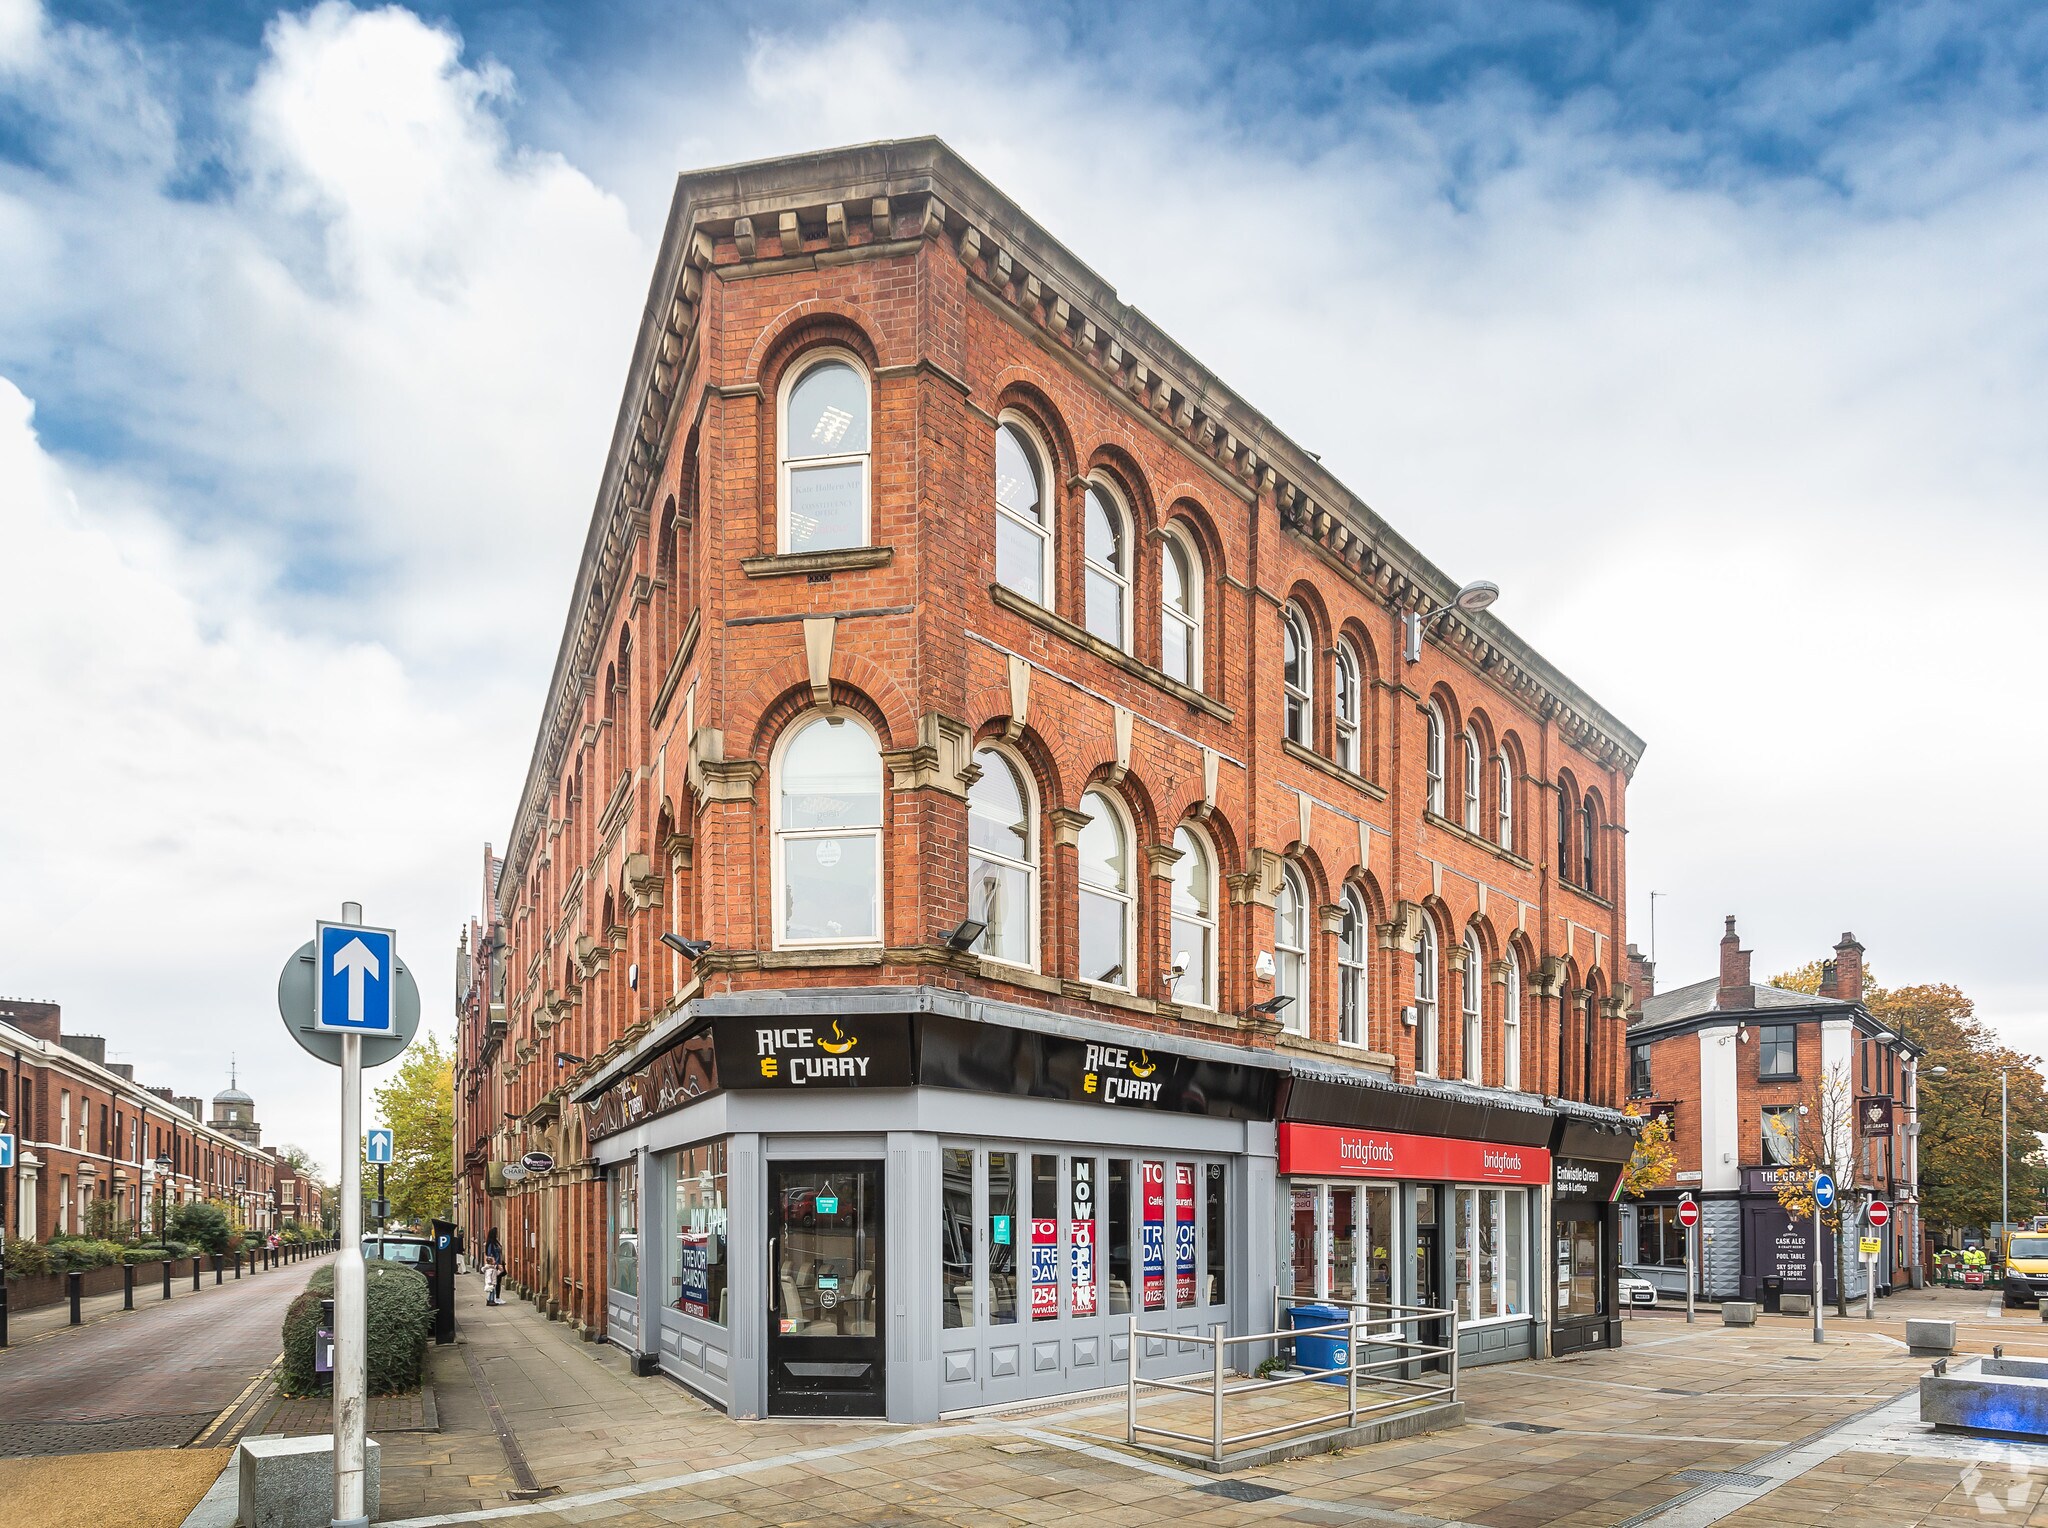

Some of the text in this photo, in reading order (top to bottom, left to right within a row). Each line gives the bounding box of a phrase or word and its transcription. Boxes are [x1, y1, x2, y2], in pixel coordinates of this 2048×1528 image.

[755, 1028, 814, 1055] RICE
[1083, 1044, 1129, 1072] RICE
[790, 1056, 870, 1084] CURRY
[1104, 1077, 1162, 1103] CURRY
[1340, 1137, 1394, 1165] bridgfords
[1483, 1150, 1522, 1173] bridgfords
[1143, 1163, 1163, 1184] TO
[1175, 1165, 1192, 1185] ET
[1556, 1166, 1598, 1182] Entwistle Green
[1761, 1171, 1820, 1182] THE GRAPE
[1073, 1162, 1092, 1220] NOW
[1557, 1181, 1568, 1191] Sales
[691, 1208, 727, 1235] NOW OPEN
[1032, 1222, 1092, 1235] TO ET
[1776, 1237, 1806, 1245] CASK ALES
[683, 1249, 706, 1270] TREVOR
[1075, 1230, 1091, 1307] OPEN
[682, 1267, 707, 1290] DAWSON
